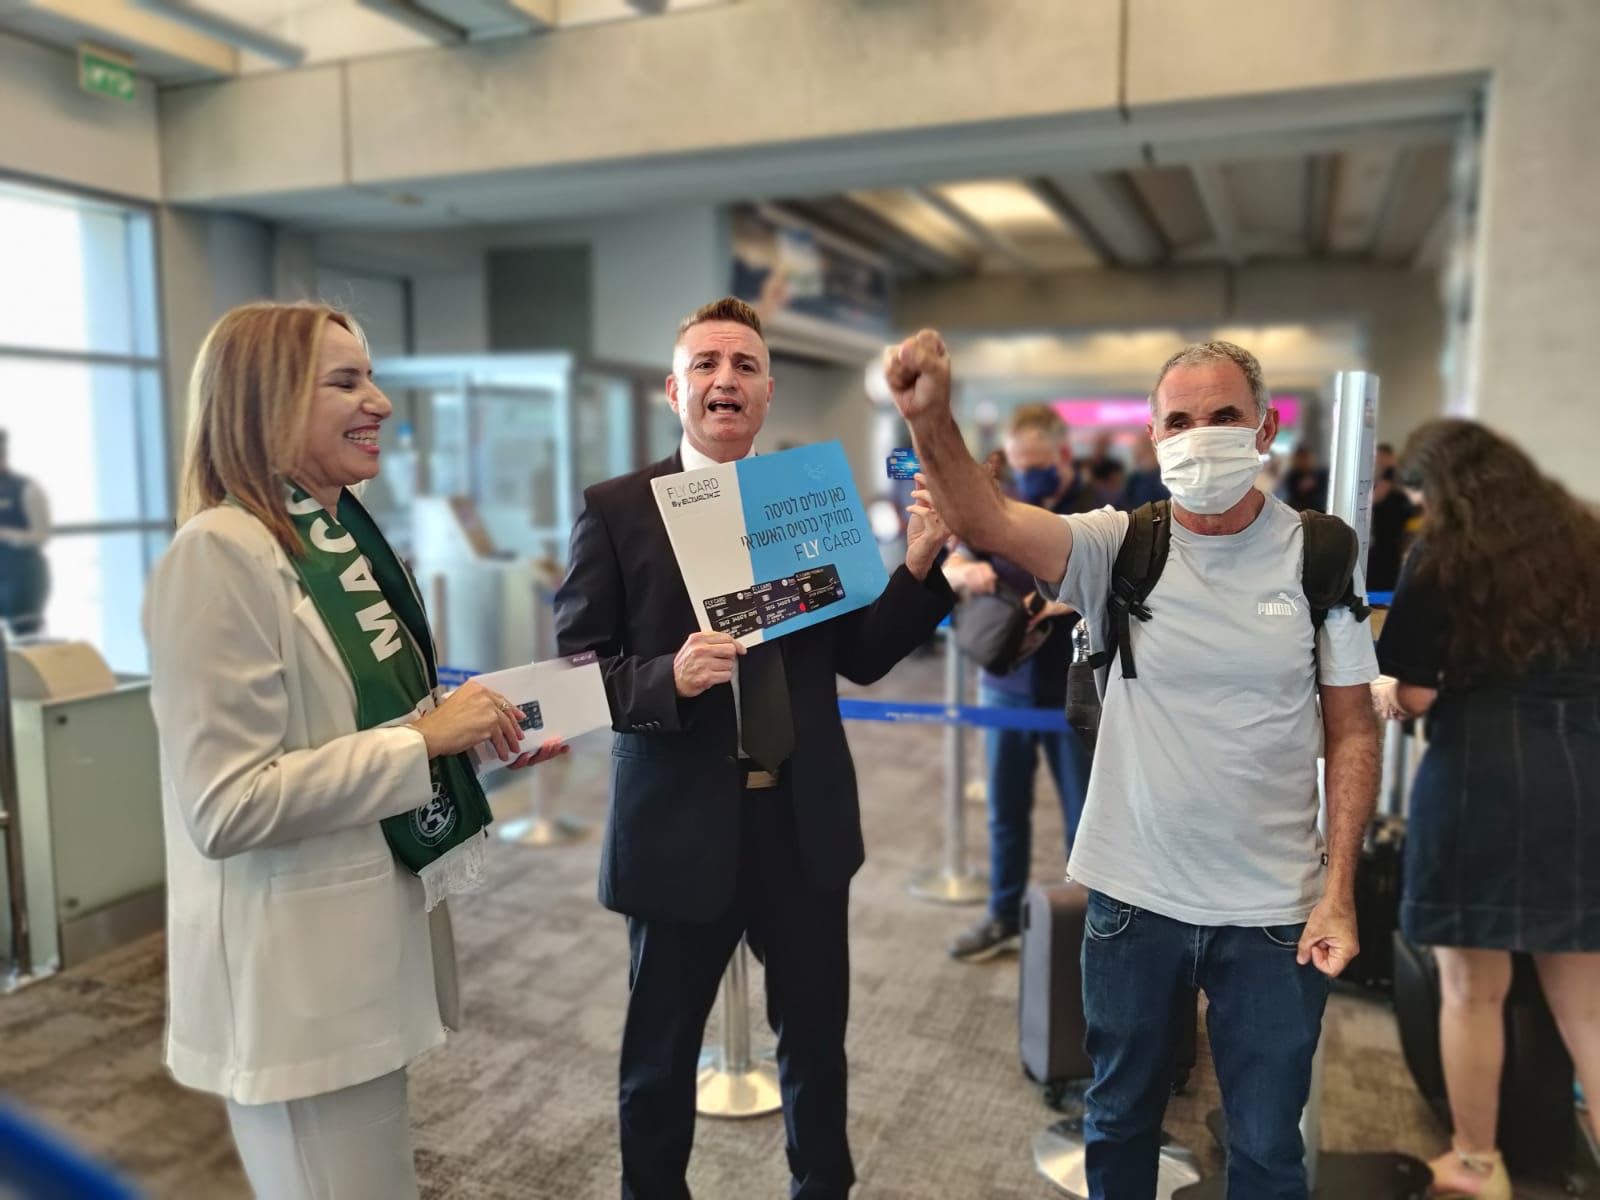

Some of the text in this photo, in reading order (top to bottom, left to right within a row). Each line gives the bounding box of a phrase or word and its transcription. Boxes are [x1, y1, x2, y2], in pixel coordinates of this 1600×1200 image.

[688, 477, 719, 494] CARD
[764, 486, 846, 520] כאן עולים לטיסה
[740, 507, 854, 550] מחזיקי כרטיס האשראי
[794, 528, 861, 561] FLY CARD
[1257, 602, 1293, 616] PUMA
